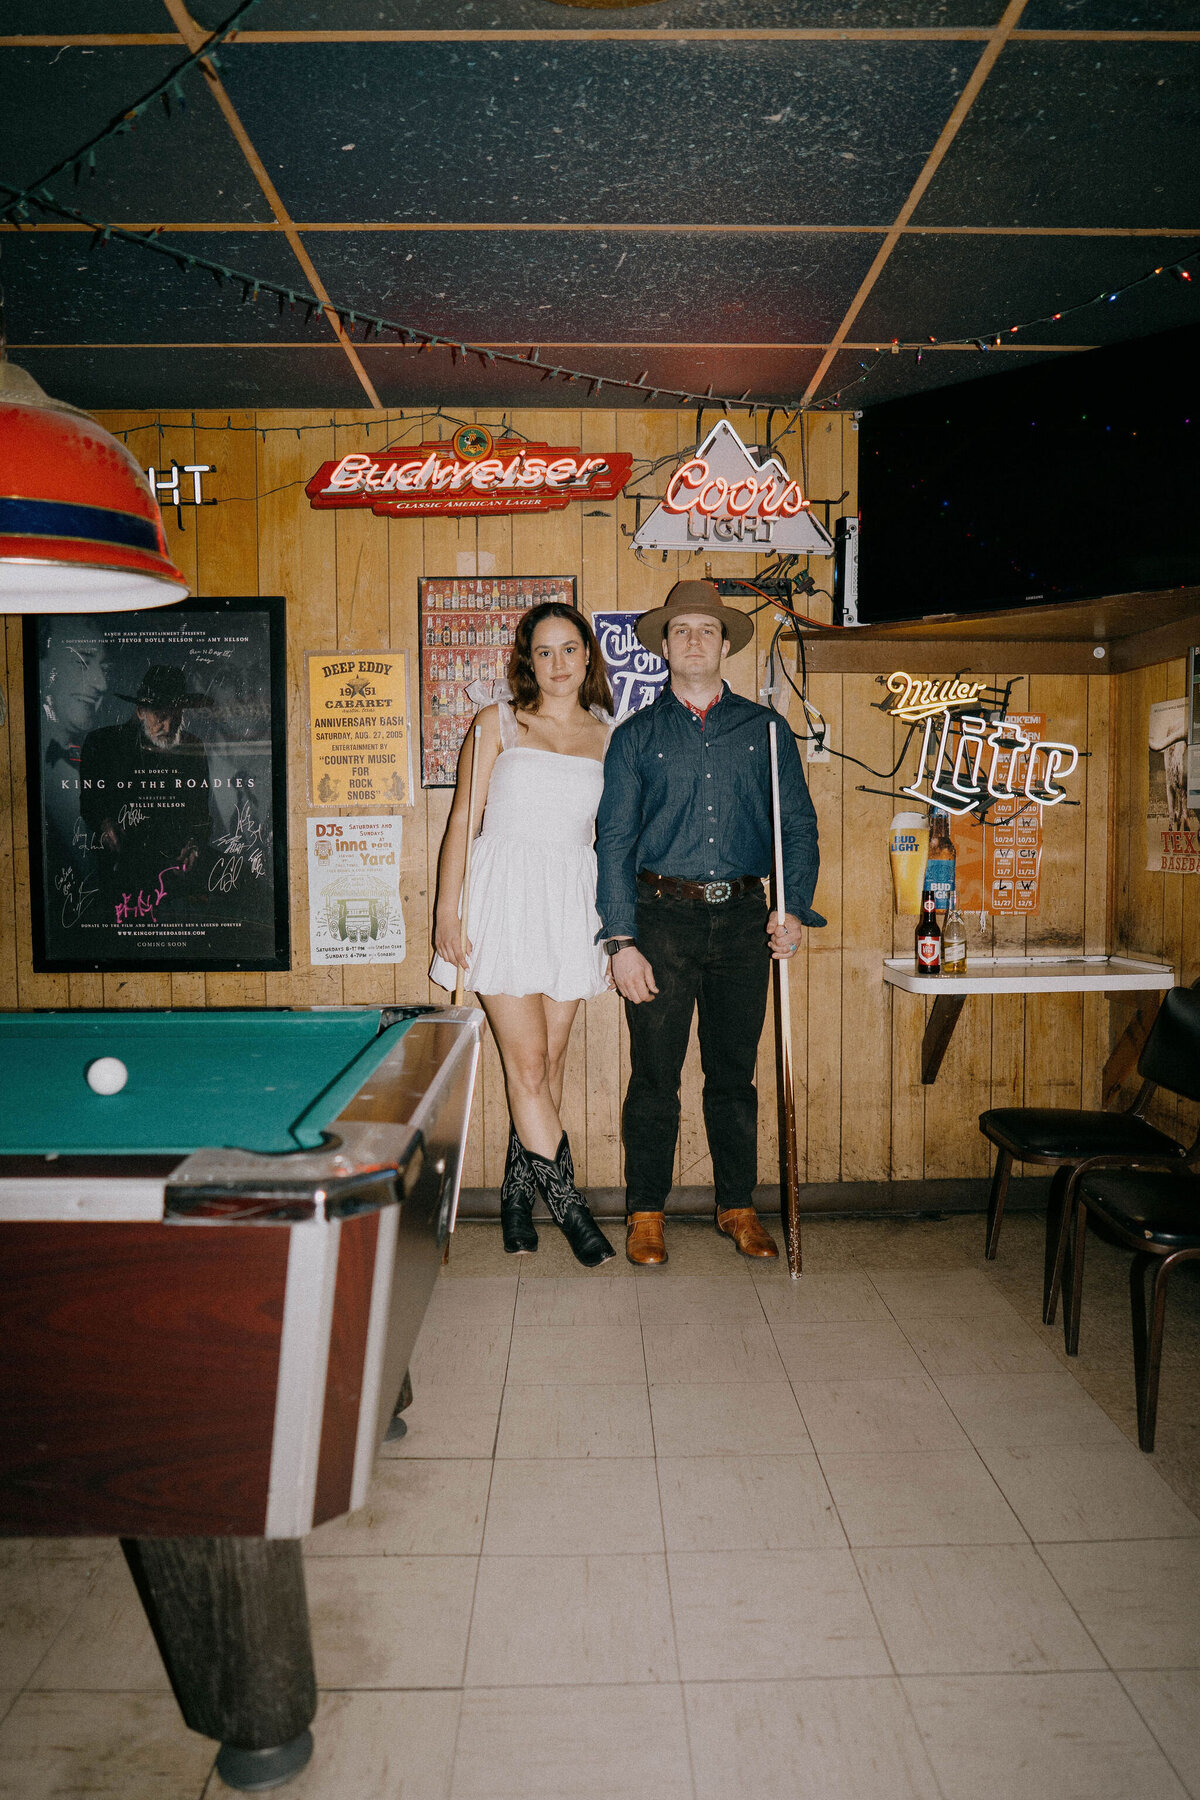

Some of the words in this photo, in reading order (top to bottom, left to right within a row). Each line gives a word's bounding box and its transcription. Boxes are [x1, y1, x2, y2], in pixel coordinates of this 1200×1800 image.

[320, 450, 610, 494] Budweiser
[666, 459, 811, 518] Coors
[687, 512, 780, 542] LIGHT
[322, 661, 356, 678] DEEP
[358, 660, 393, 676] EDDY
[886, 671, 987, 710] Miller
[324, 698, 393, 709] CABARET
[314, 717, 377, 728] ANNIVERSARY
[380, 716, 404, 726] BASH
[1004, 715, 1040, 724] OOK'EM!
[316, 732, 353, 741] SATURDAY,
[354, 732, 370, 740] AUG.
[373, 731, 384, 740] 27,
[386, 730, 404, 739] 2005
[368, 754, 396, 764] MUSIC
[903, 709, 1079, 815] Lite
[352, 767, 370, 776] FOR
[61, 779, 106, 790] KING
[117, 781, 133, 789] OF
[140, 780, 166, 789] THE
[175, 778, 256, 788] ROADIES
[349, 778, 373, 788] ROCK
[316, 824, 344, 838] DJs
[335, 838, 368, 852] inna
[894, 835, 916, 844] BUD
[1160, 832, 1200, 854] TEX
[890, 844, 920, 852] LIGHT
[360, 852, 396, 866] Yard
[930, 882, 951, 891] BUD
[1021, 880, 1033, 890] W
